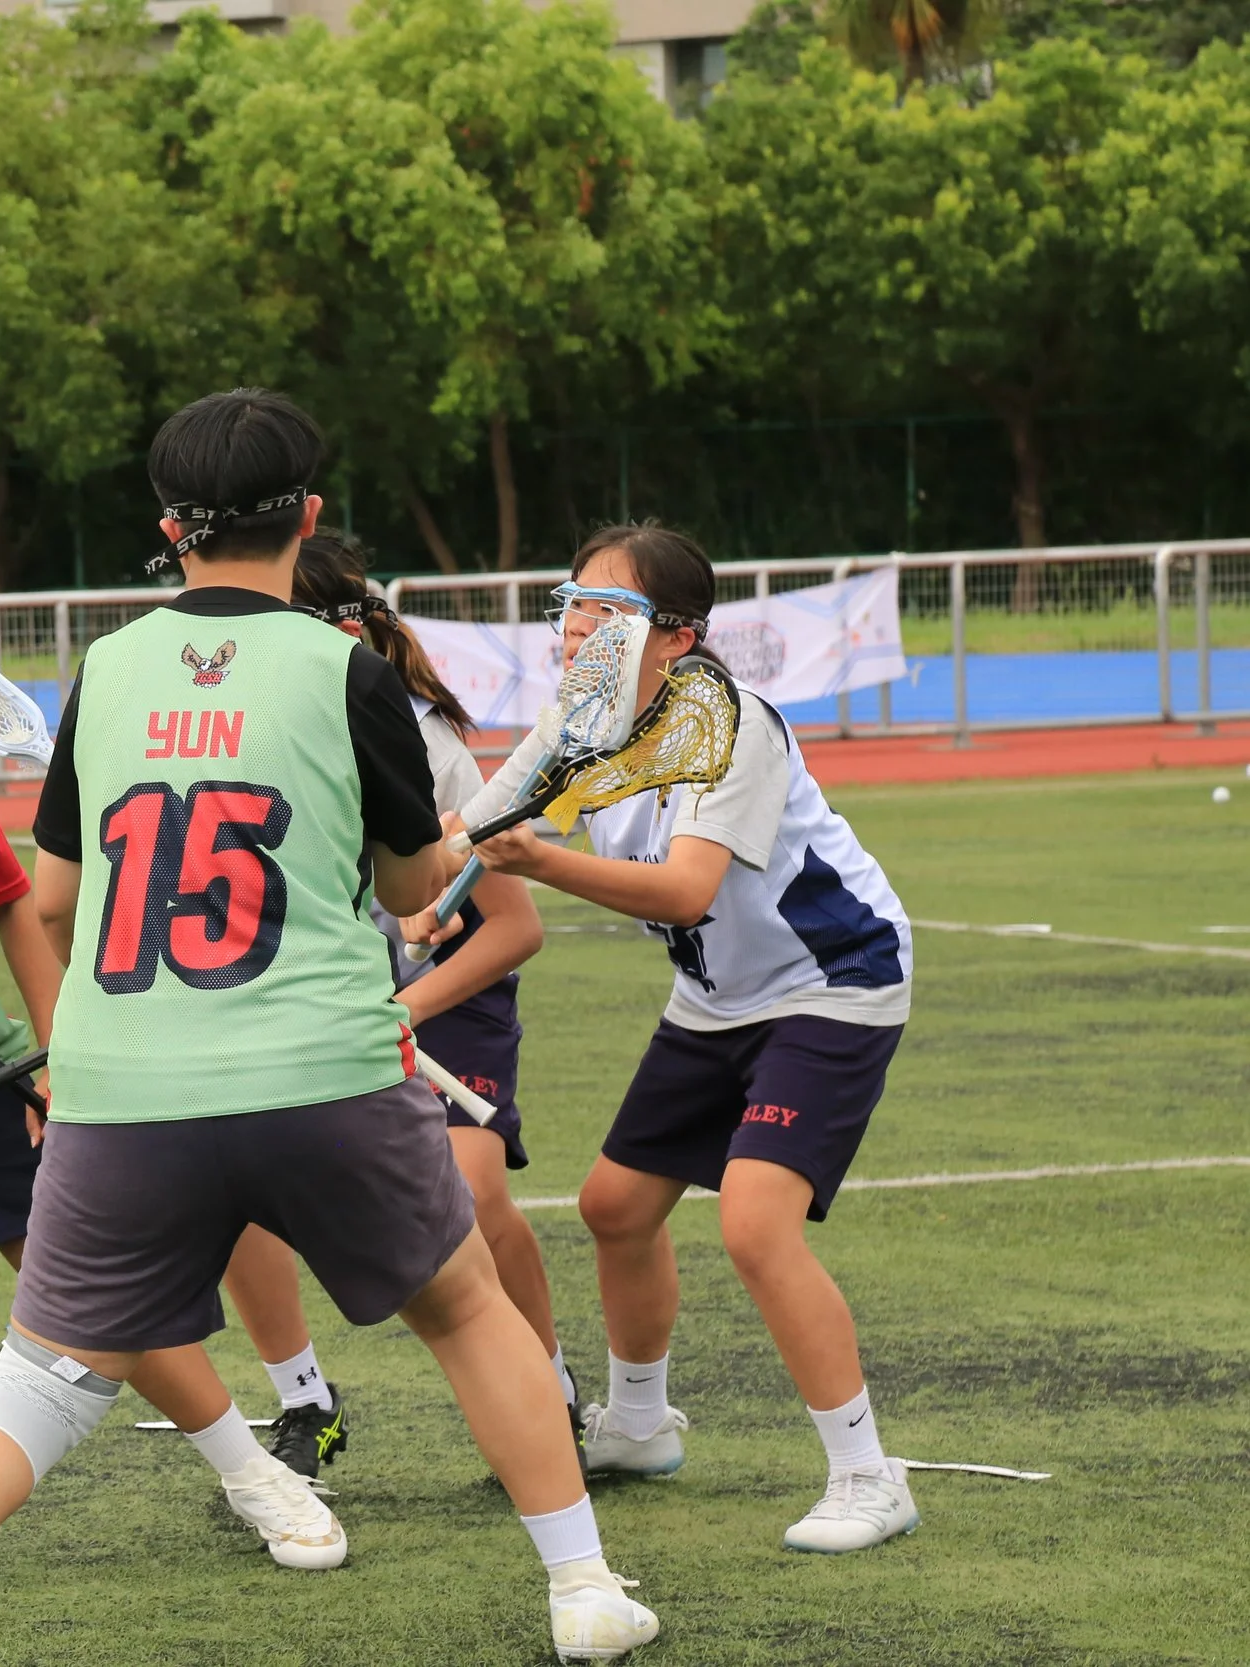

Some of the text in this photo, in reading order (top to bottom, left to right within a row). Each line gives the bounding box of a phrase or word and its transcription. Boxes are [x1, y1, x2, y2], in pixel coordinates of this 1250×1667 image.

[256, 493, 297, 512] STX
[176, 523, 214, 555] STX
[338, 602, 362, 616] STX
[657, 613, 685, 627] STX
[145, 710, 244, 759] YUN
[94, 780, 293, 995] 15
